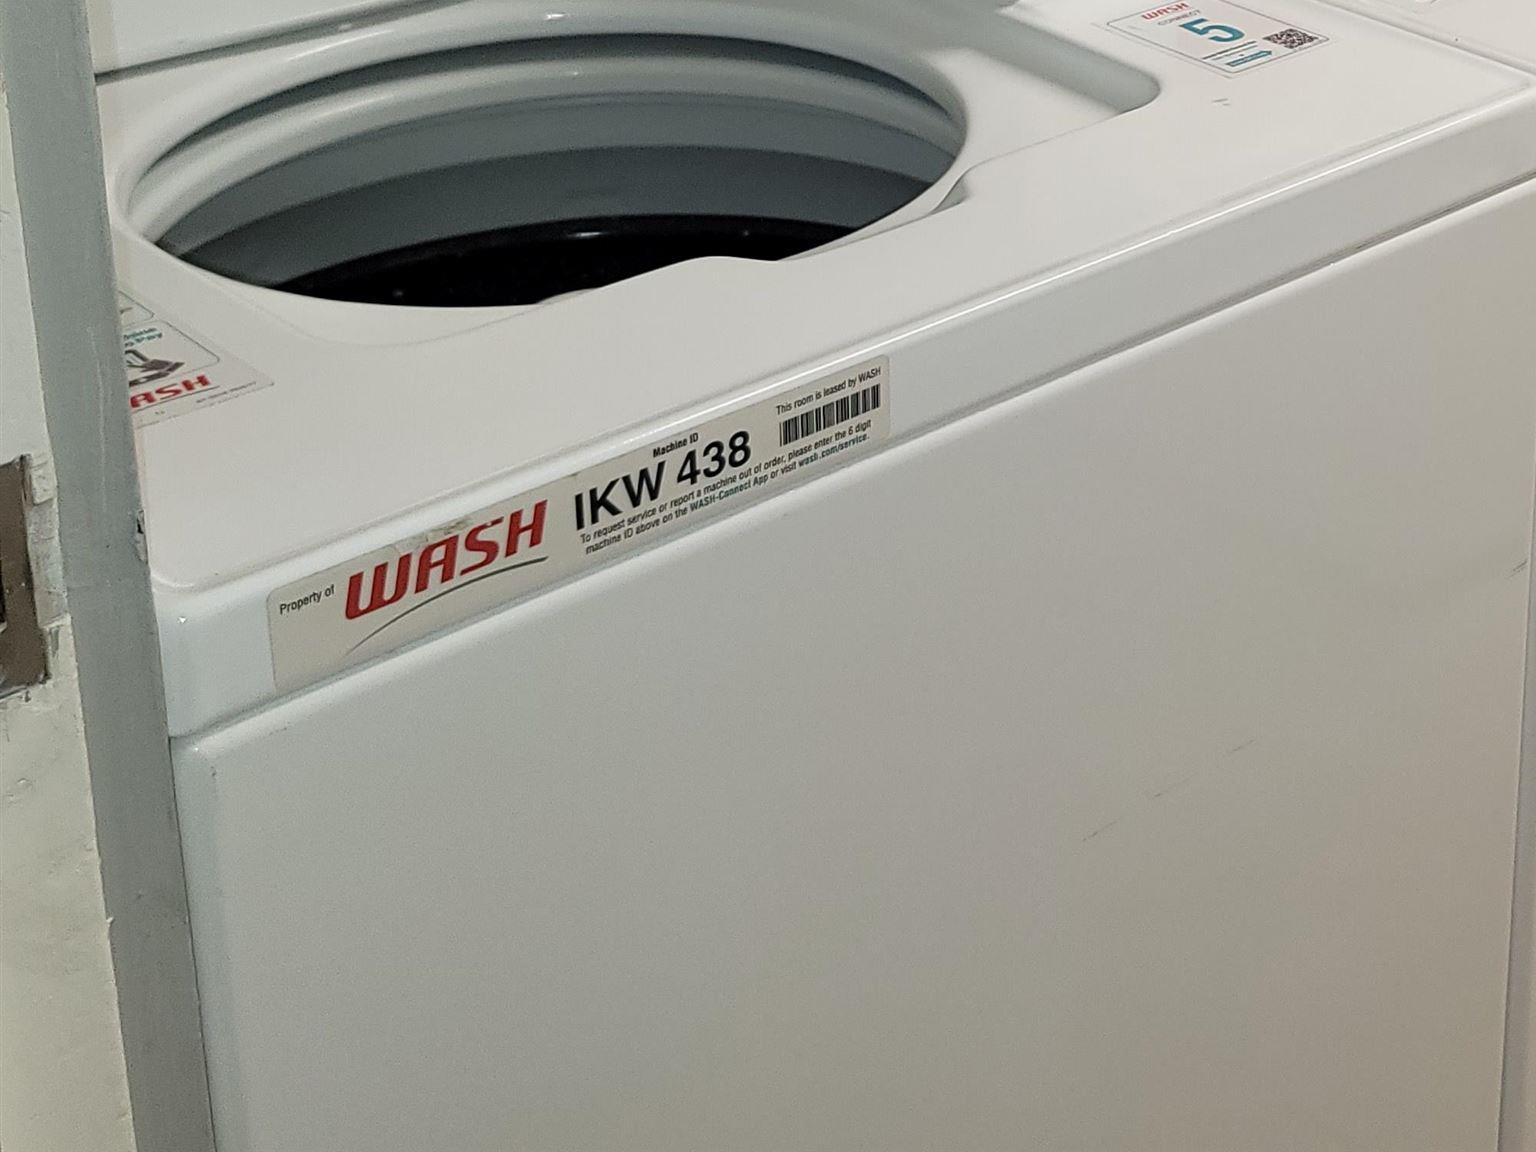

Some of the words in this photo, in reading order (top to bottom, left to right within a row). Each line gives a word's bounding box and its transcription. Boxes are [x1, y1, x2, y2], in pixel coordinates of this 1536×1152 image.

[1141, 2, 1190, 21] WASH
[1179, 18, 1245, 43] 5
[129, 374, 212, 409] ASH
[775, 402, 793, 416] This
[793, 395, 814, 411] room
[815, 390, 822, 402] is
[823, 379, 847, 399] leased
[848, 376, 857, 390] by
[858, 366, 882, 383] WASH
[652, 436, 688, 459] Machine
[689, 432, 700, 444] ID
[574, 461, 666, 531] IKW
[676, 430, 752, 486] 438
[580, 533, 592, 545] To
[593, 518, 626, 541] request
[627, 508, 657, 527] service
[658, 502, 668, 513] or
[669, 493, 696, 511] report
[703, 473, 738, 496] machine
[738, 468, 753, 481] out
[753, 462, 763, 475] of
[763, 453, 787, 472] order,
[787, 445, 813, 464] please
[814, 435, 834, 450] enter
[834, 430, 848, 444] the
[854, 419, 872, 436] digit
[586, 534, 622, 554] machine
[623, 527, 634, 540] ID
[635, 516, 661, 535] above
[662, 513, 673, 524] on
[674, 506, 688, 520] the
[689, 480, 752, 513] WASH-Connect
[753, 474, 769, 491] App
[770, 469, 780, 480] or
[780, 460, 797, 476] visit
[797, 434, 870, 468] wash.com/service.
[345, 498, 548, 621] WASH
[279, 589, 323, 615] Property
[324, 584, 336, 599] of
